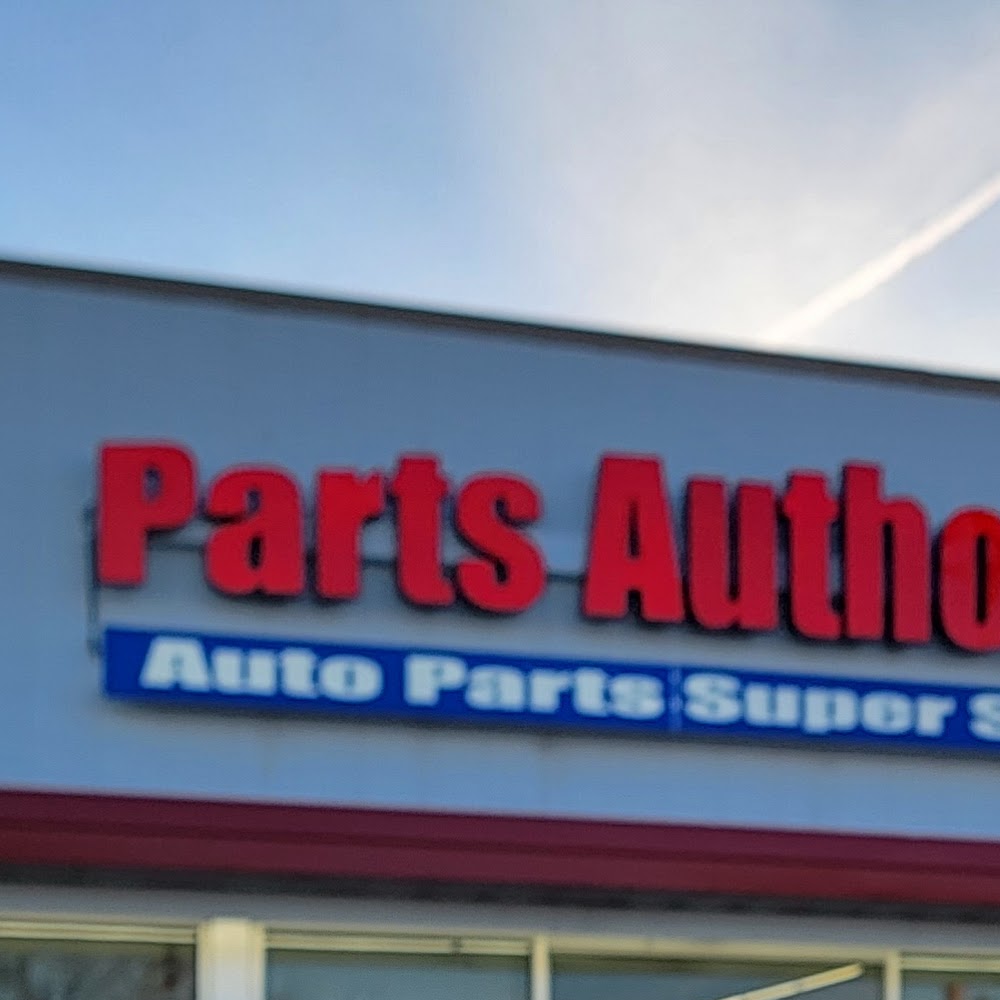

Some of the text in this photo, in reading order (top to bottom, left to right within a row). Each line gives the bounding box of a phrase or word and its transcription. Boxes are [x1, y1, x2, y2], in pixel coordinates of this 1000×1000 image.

[98, 440, 547, 613] Parts
[140, 637, 382, 702] Auto
[405, 654, 664, 721] Parts
[683, 672, 954, 735] Super
